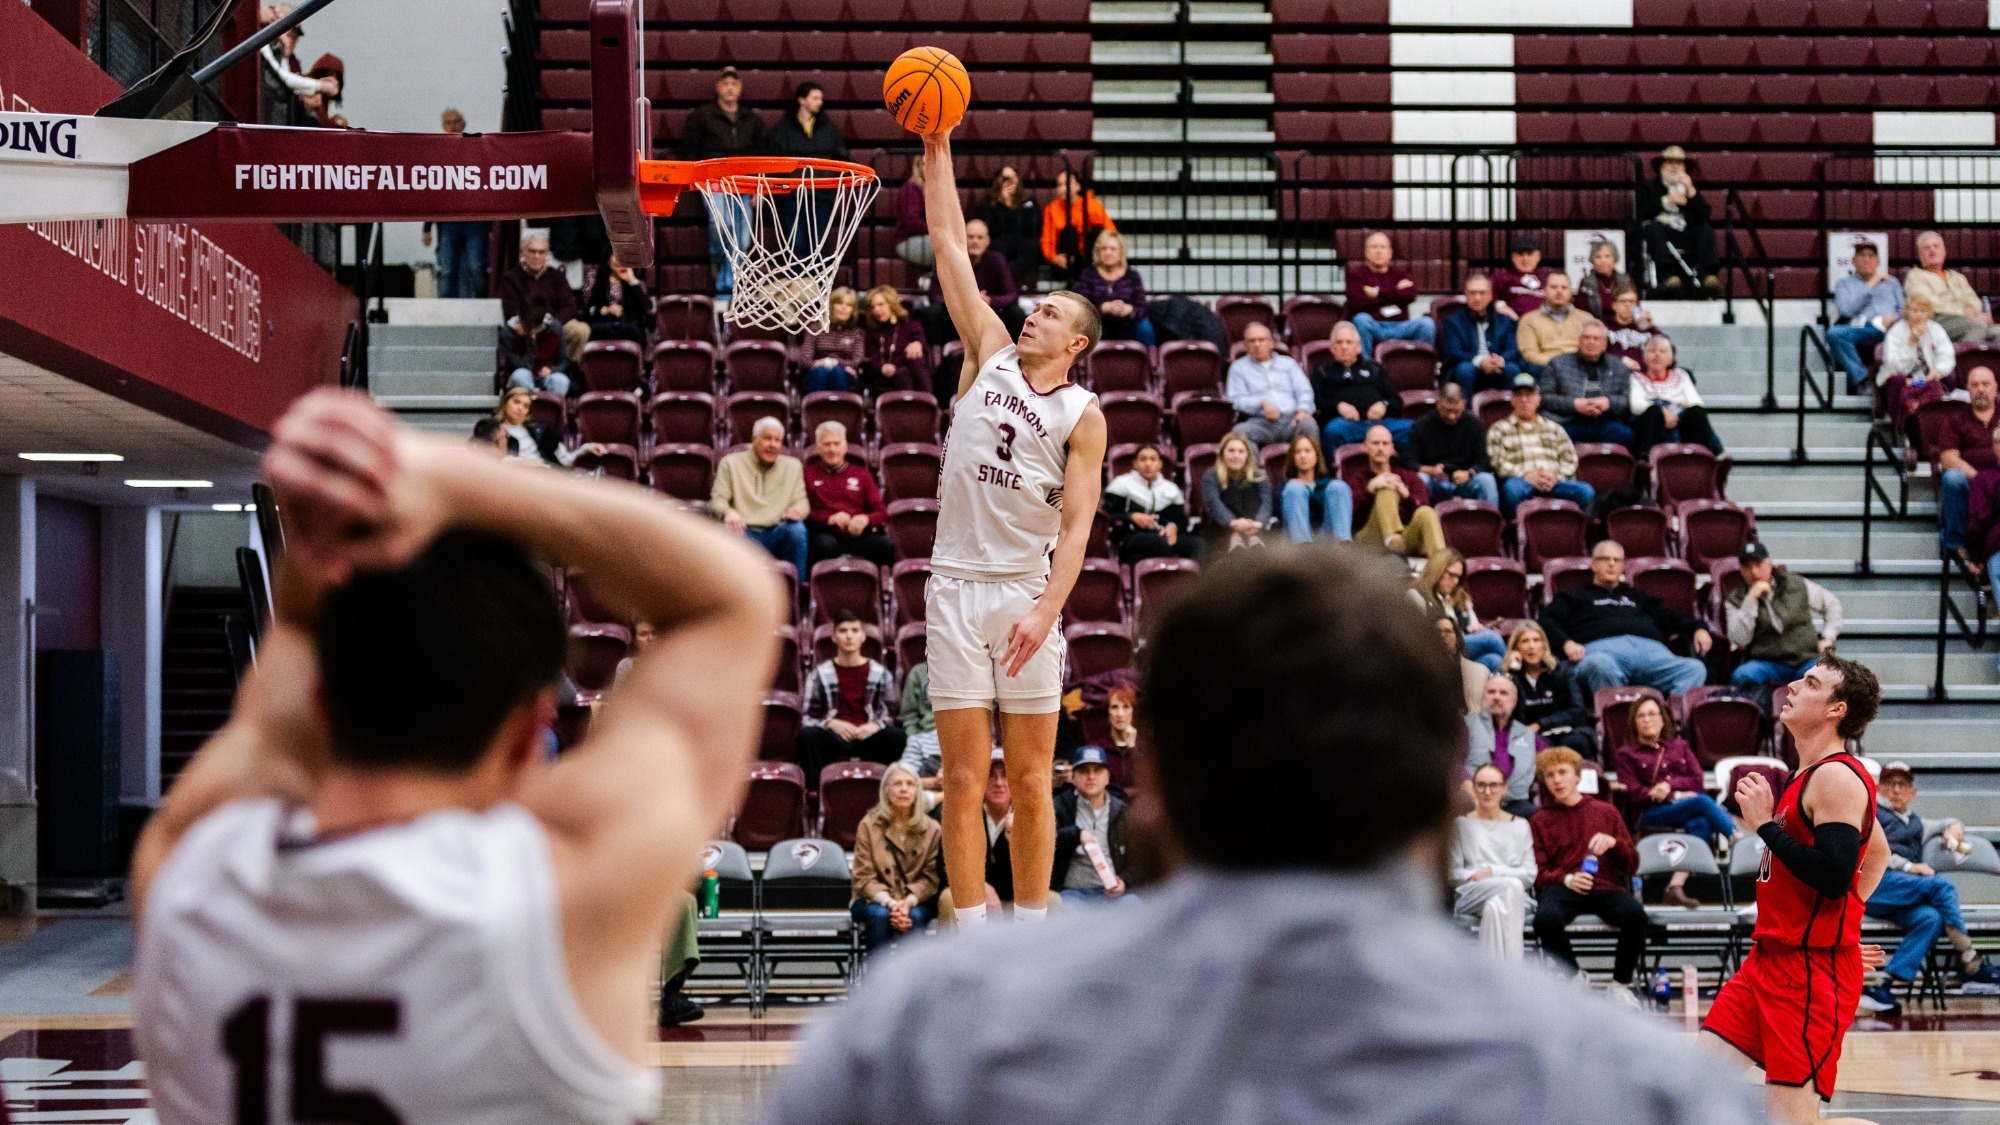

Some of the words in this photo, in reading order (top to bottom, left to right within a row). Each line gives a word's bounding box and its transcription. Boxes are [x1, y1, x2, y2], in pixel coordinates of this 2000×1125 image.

[888, 88, 912, 120] ilson
[235, 164, 547, 190] FIGHTINGFALCONS.COM
[134, 224, 187, 320] STATE
[190, 228, 261, 363] ATHLETICS
[984, 390, 1049, 438] FAIRMONT
[996, 422, 1017, 461] 3
[978, 464, 1022, 490] STATE
[1756, 846, 1772, 883] 0
[218, 992, 410, 1125] 15
